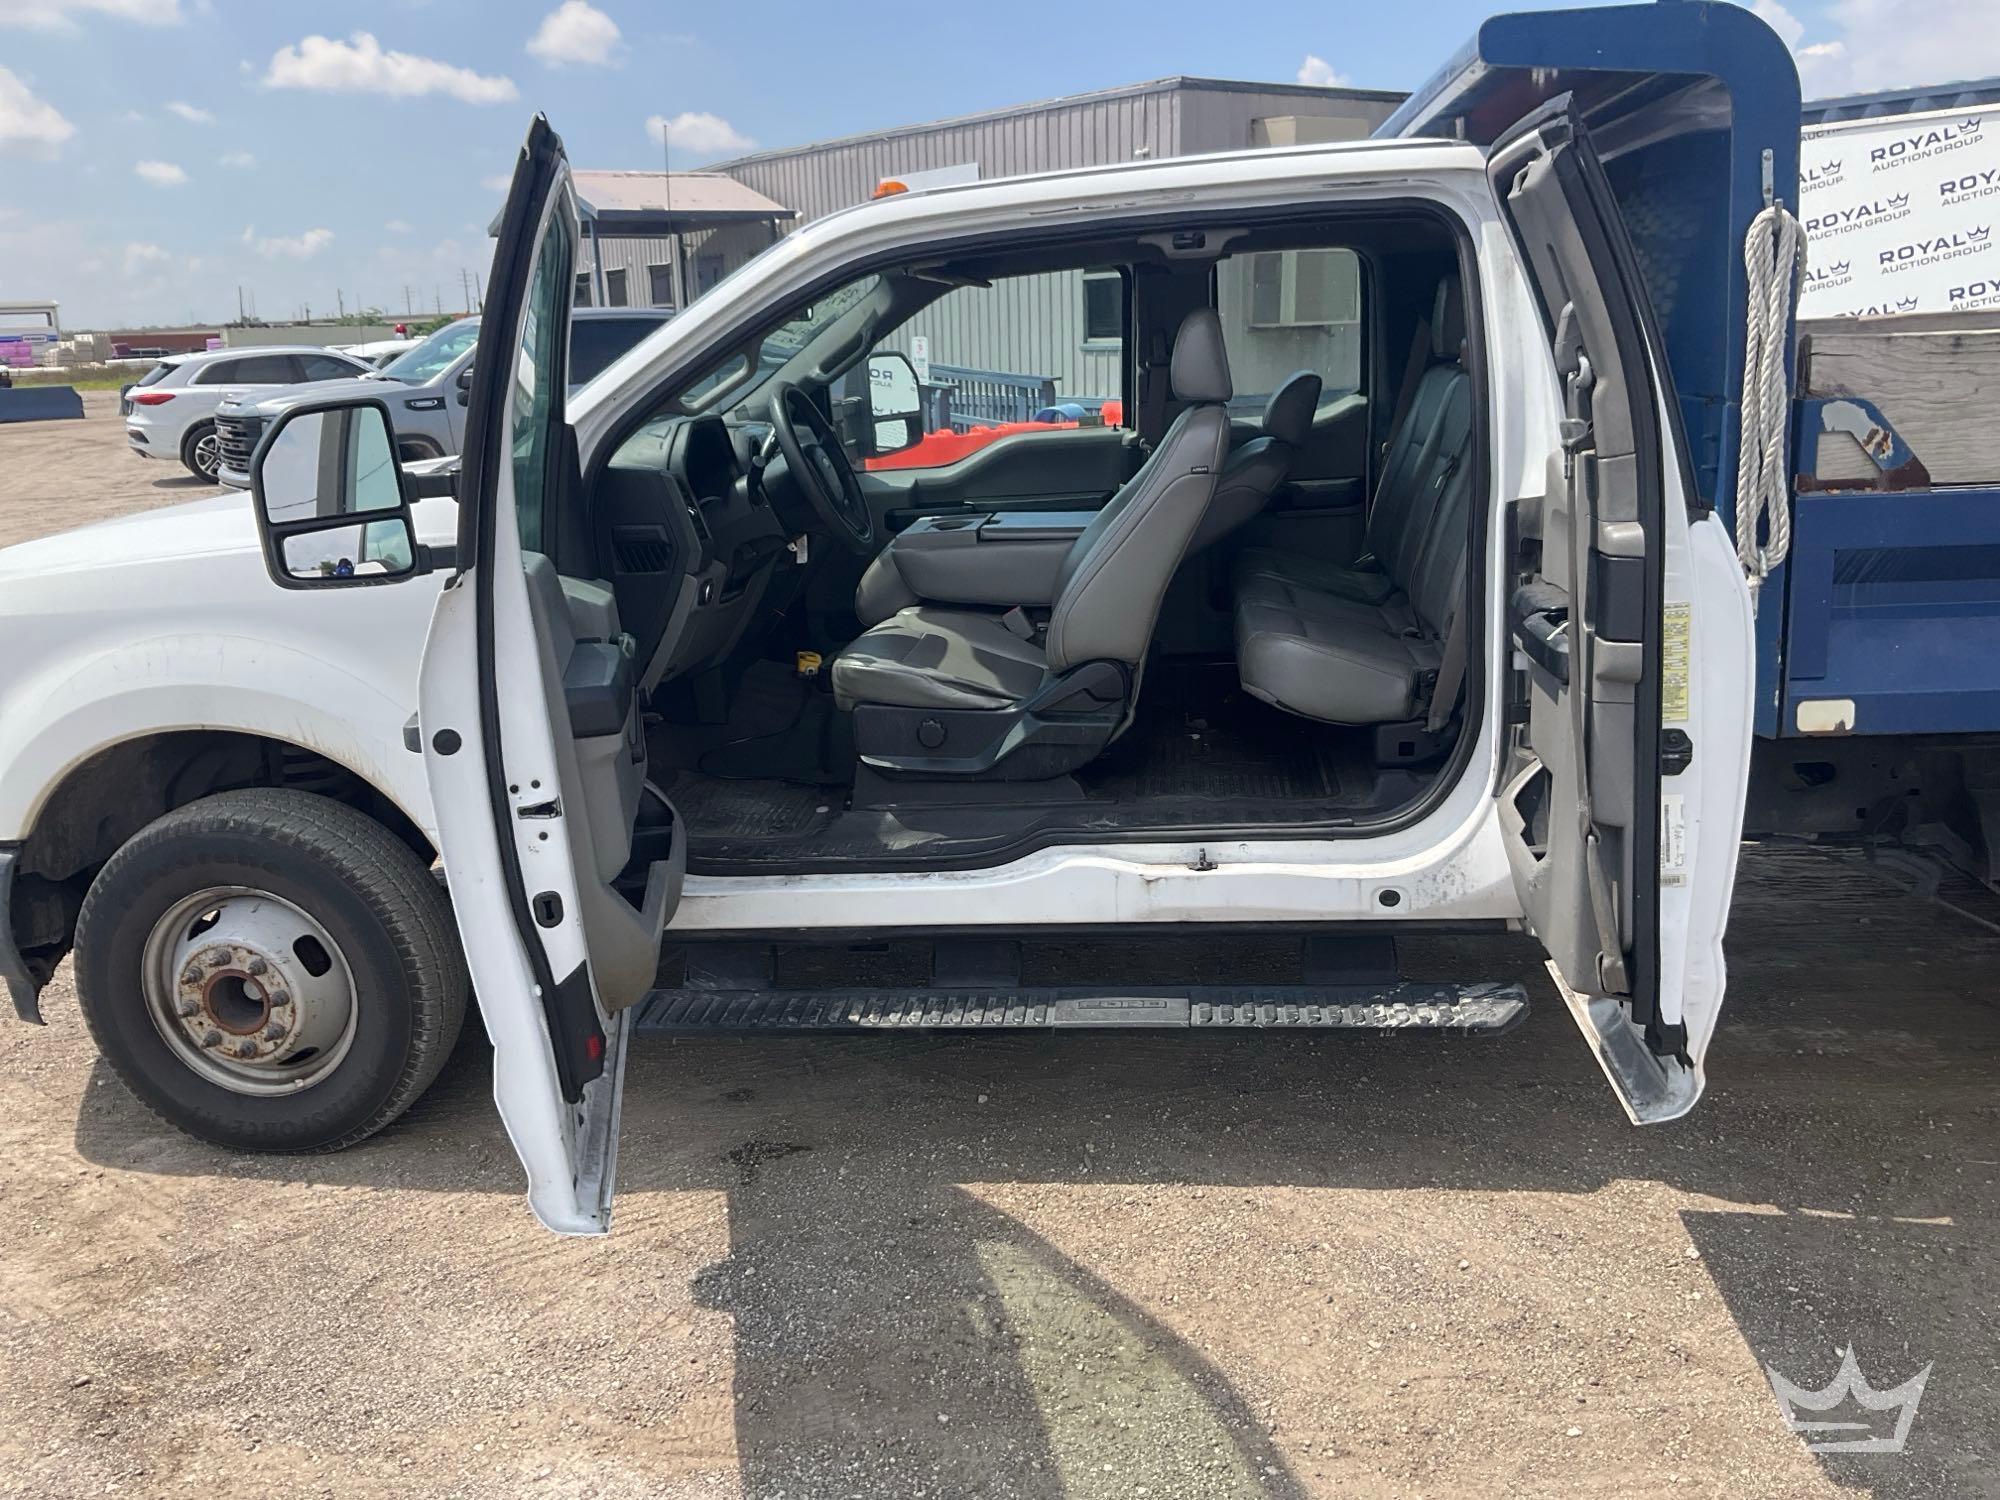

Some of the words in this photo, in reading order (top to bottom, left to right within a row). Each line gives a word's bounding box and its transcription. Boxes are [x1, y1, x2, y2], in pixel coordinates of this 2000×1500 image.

[1870, 128, 1957, 162] ROYAL
[1872, 149, 1931, 173] AUCTION
[1934, 134, 1983, 155] GROUP
[1801, 176, 1844, 194] GROUP
[1940, 169, 2000, 196] ROY
[1805, 201, 1887, 232] ROYAL
[1808, 222, 1862, 242] AUCTION
[1865, 209, 1911, 228] GROUP
[1880, 234, 1966, 265] ROYAL
[1881, 255, 1940, 275] AUCTION
[1943, 242, 1992, 260] GROUP
[1809, 276, 1852, 293] GROUP
